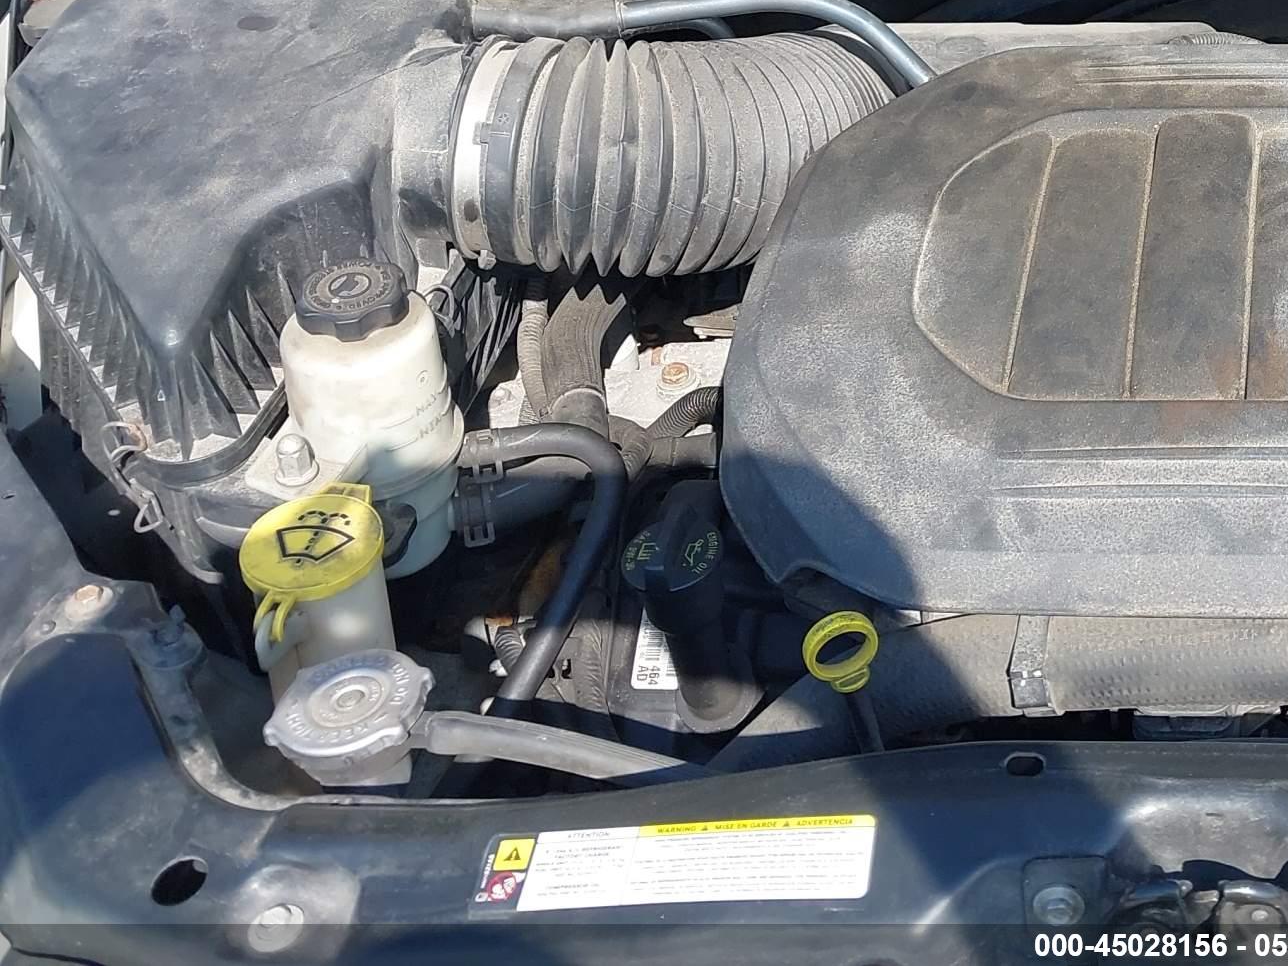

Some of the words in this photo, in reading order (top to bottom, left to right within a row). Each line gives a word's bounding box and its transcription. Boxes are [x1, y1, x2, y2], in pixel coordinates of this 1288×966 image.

[704, 531, 718, 560] ENGINE
[691, 562, 708, 575] OIL
[648, 665, 660, 685] 464
